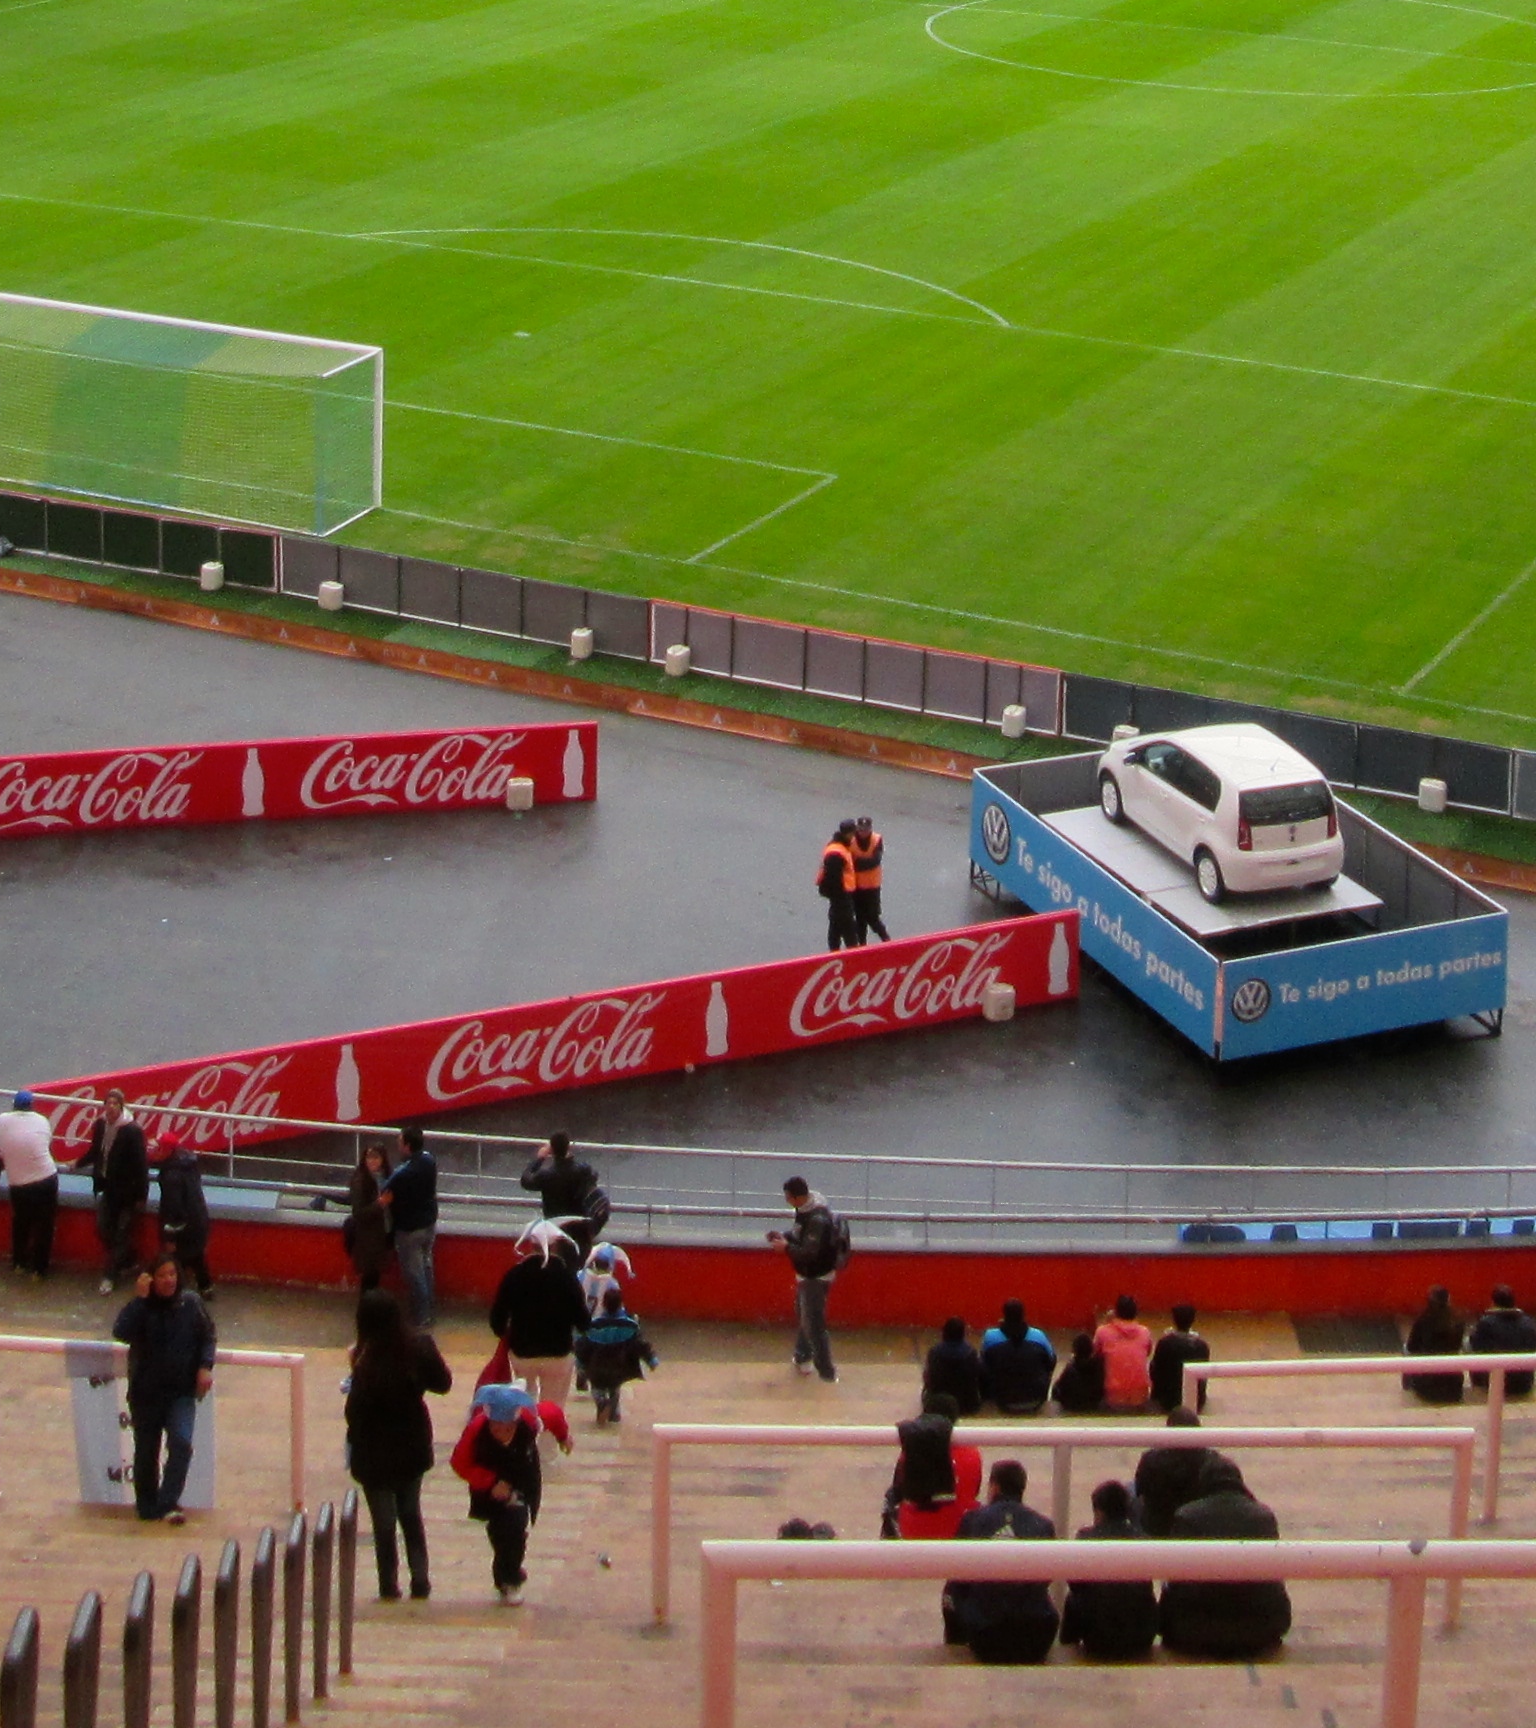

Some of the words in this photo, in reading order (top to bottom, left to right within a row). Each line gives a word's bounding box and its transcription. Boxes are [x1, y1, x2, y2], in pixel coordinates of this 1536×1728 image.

[301, 731, 528, 809] Coca-Cola
[1017, 837, 1034, 873] Te
[1037, 862, 1072, 903] sigo
[1077, 897, 1089, 917] a
[1094, 902, 1142, 960] todas
[1146, 952, 1205, 1011] partes
[789, 931, 1015, 1038] Coca-Cola
[1278, 983, 1300, 1004] Te
[1307, 978, 1350, 1001] sigo
[1356, 975, 1370, 990] a
[1376, 962, 1433, 986] todas
[1439, 951, 1502, 980] partes
[425, 990, 668, 1102] Coca-Cola
[47, 1053, 295, 1150] Coa-Cola
